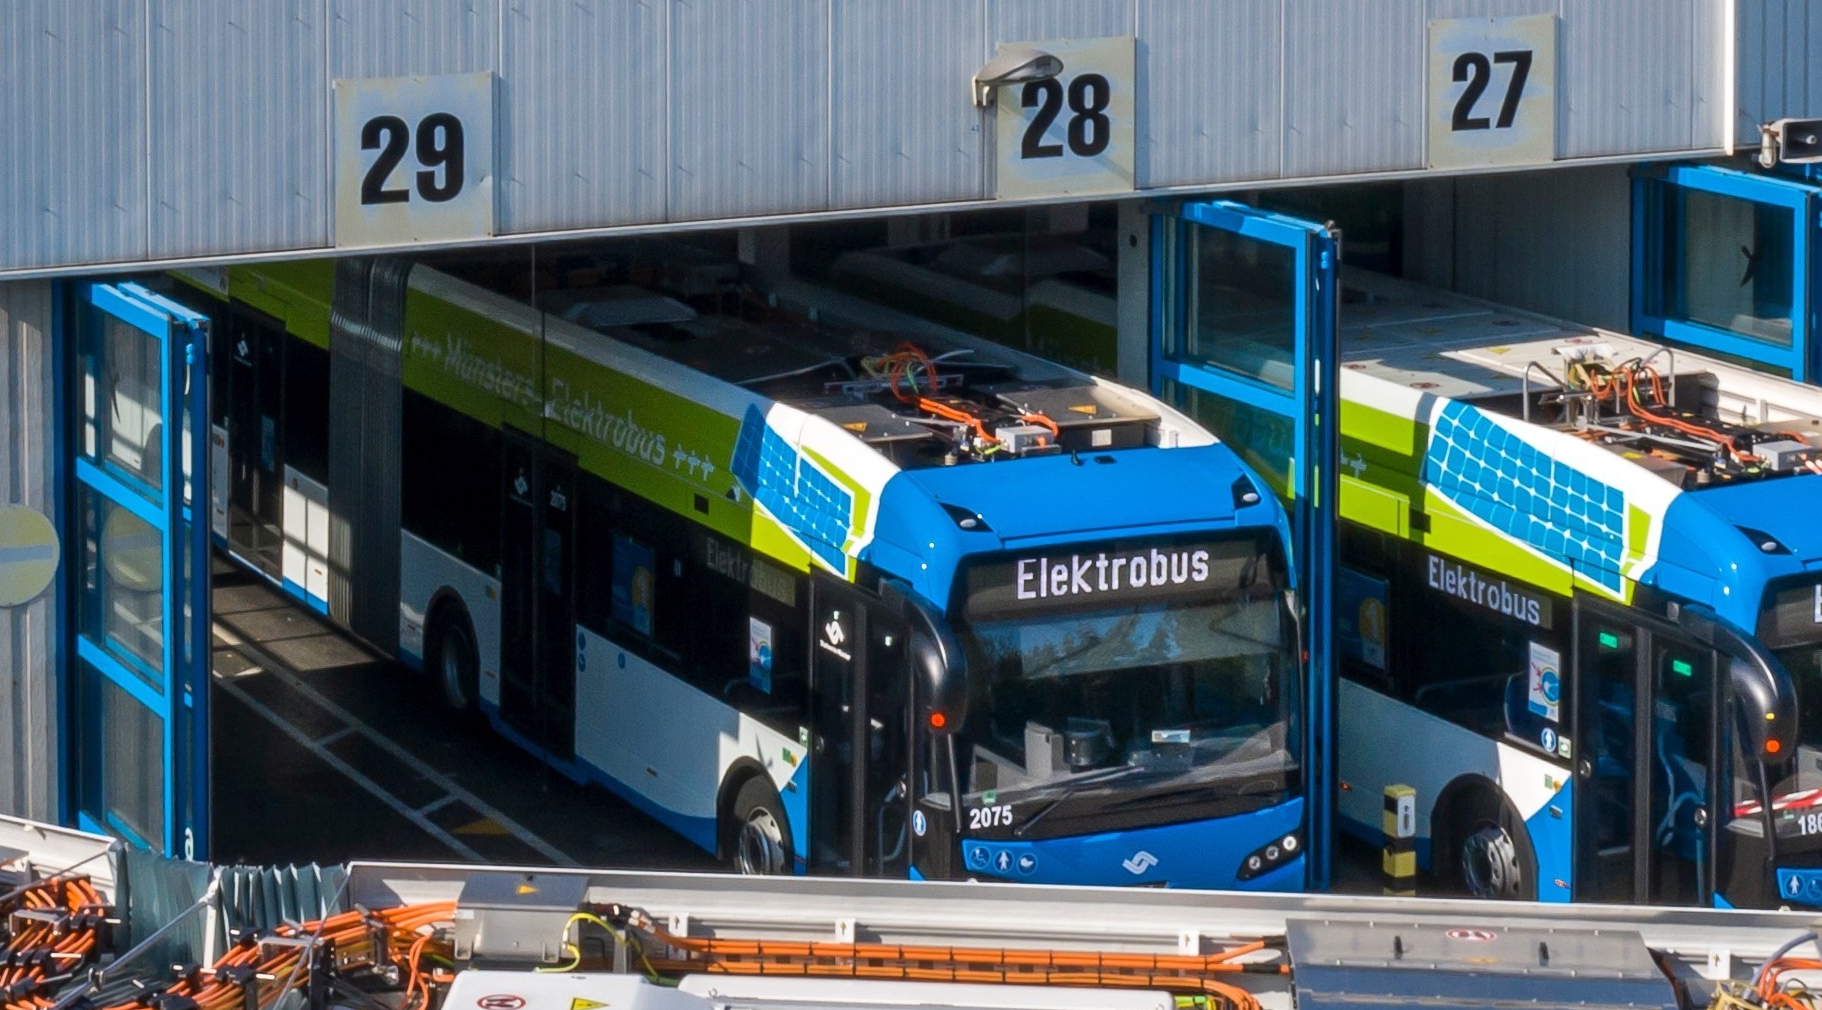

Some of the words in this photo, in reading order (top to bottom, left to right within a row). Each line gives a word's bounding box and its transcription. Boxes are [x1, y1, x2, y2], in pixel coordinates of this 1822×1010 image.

[1020, 74, 1111, 160] 28
[1451, 50, 1534, 132] 27
[360, 112, 465, 206] 29
[550, 376, 666, 465] Elektrobus
[1016, 547, 1210, 600] Elektrobus
[1428, 554, 1541, 626] Elektrobus
[969, 805, 1013, 830] 2075
